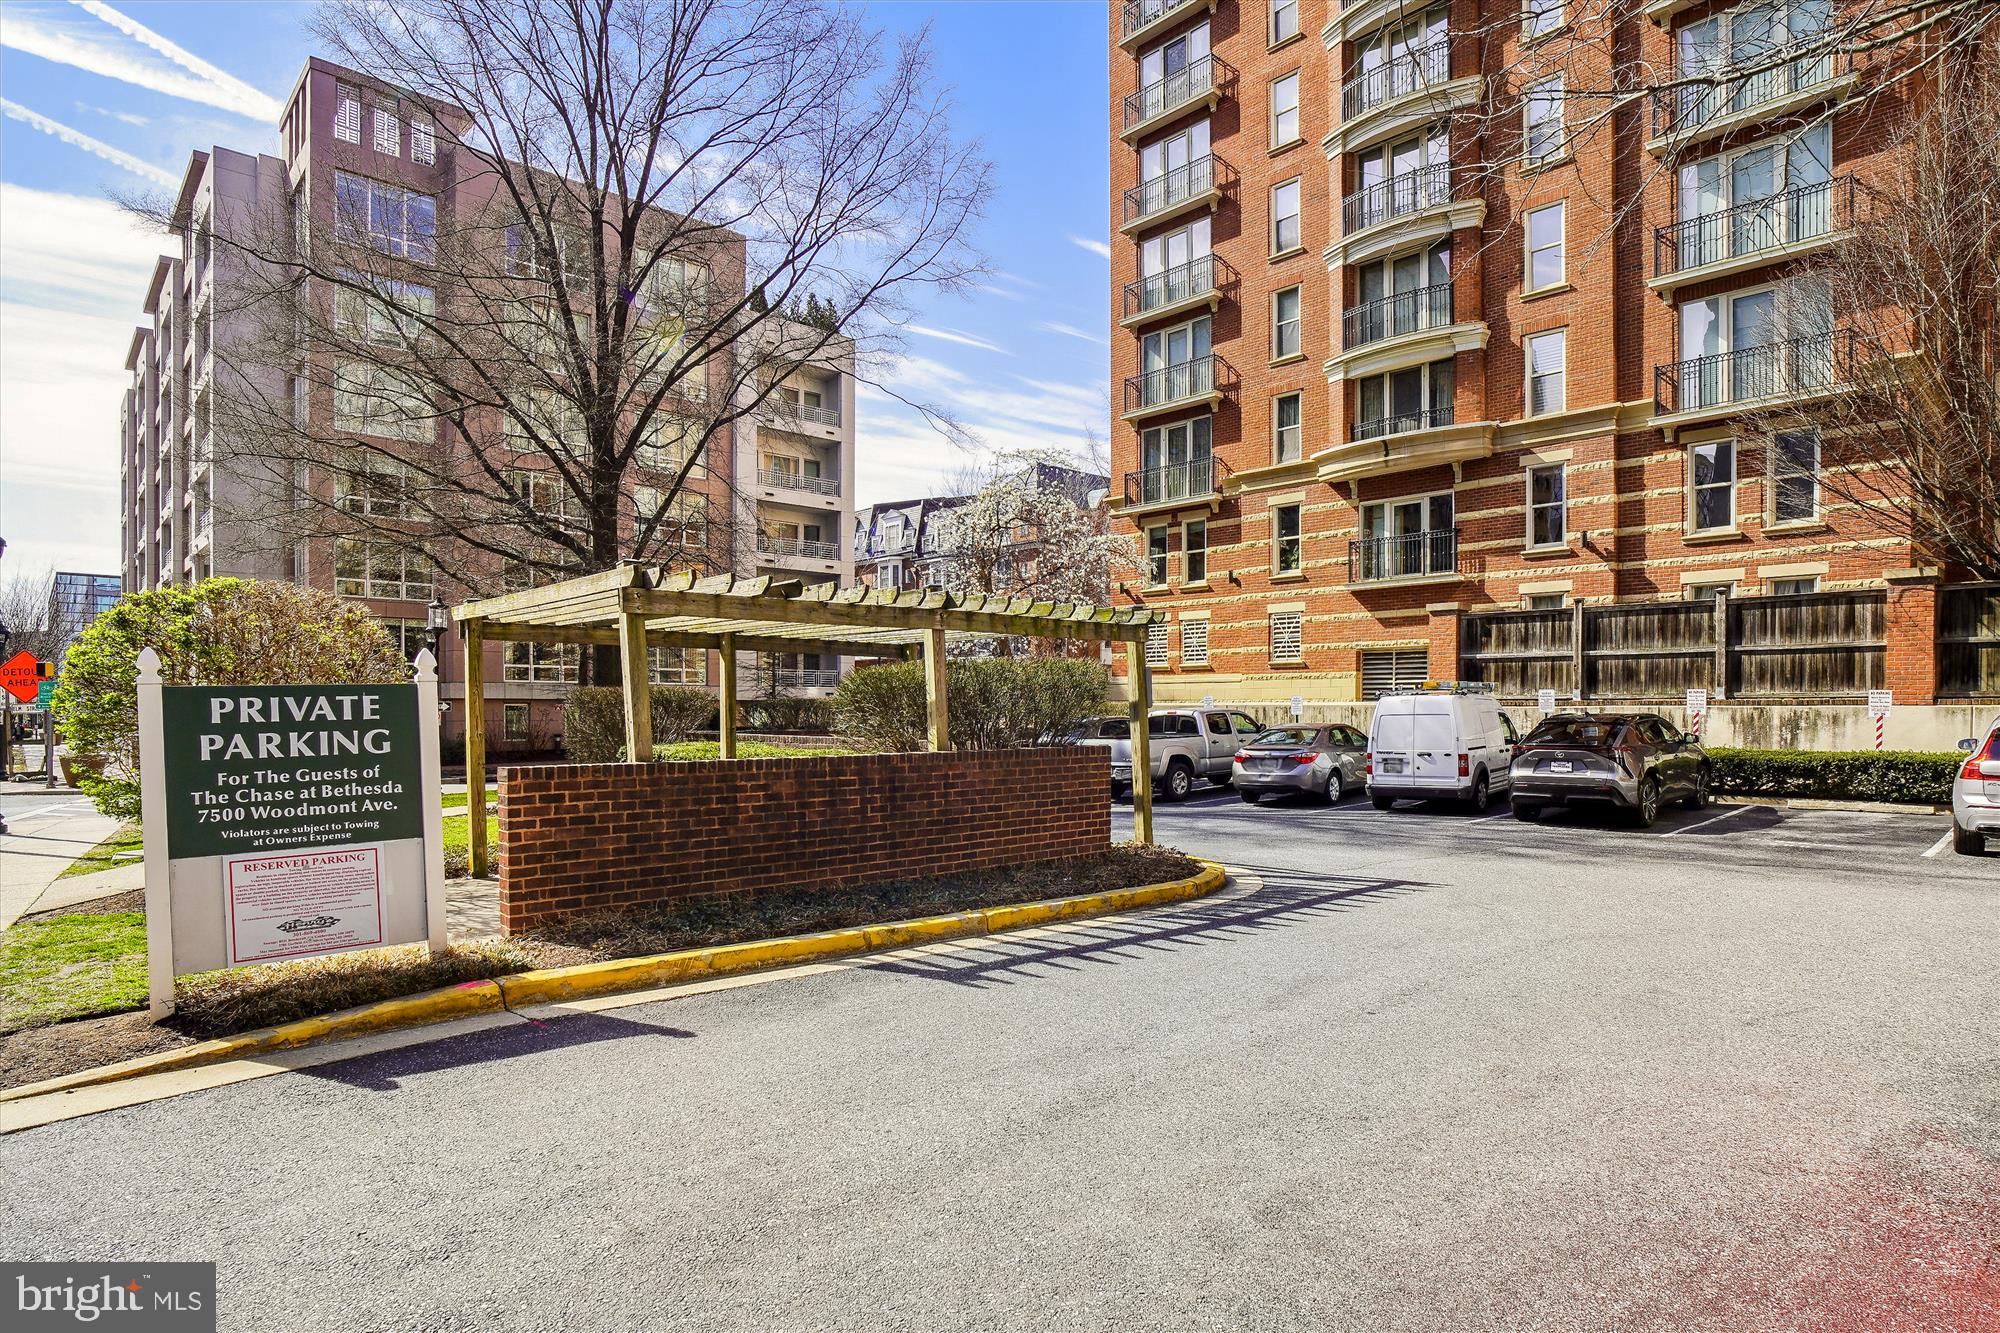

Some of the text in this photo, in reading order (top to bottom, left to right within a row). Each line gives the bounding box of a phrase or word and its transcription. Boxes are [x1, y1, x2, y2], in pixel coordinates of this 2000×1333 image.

[3, 668, 37, 676] DETOU
[210, 694, 380, 724] PRIVATE
[200, 729, 391, 761] PARKING
[217, 765, 380, 786] For The Guests of
[191, 781, 403, 806] The Chase at Bethesda
[198, 799, 398, 823] 7500 Woodmont Ave.
[221, 820, 380, 839] Violators are subject to Towing
[253, 831, 352, 846] at Owners Expense
[244, 853, 366, 872] RESERVED PARKING
